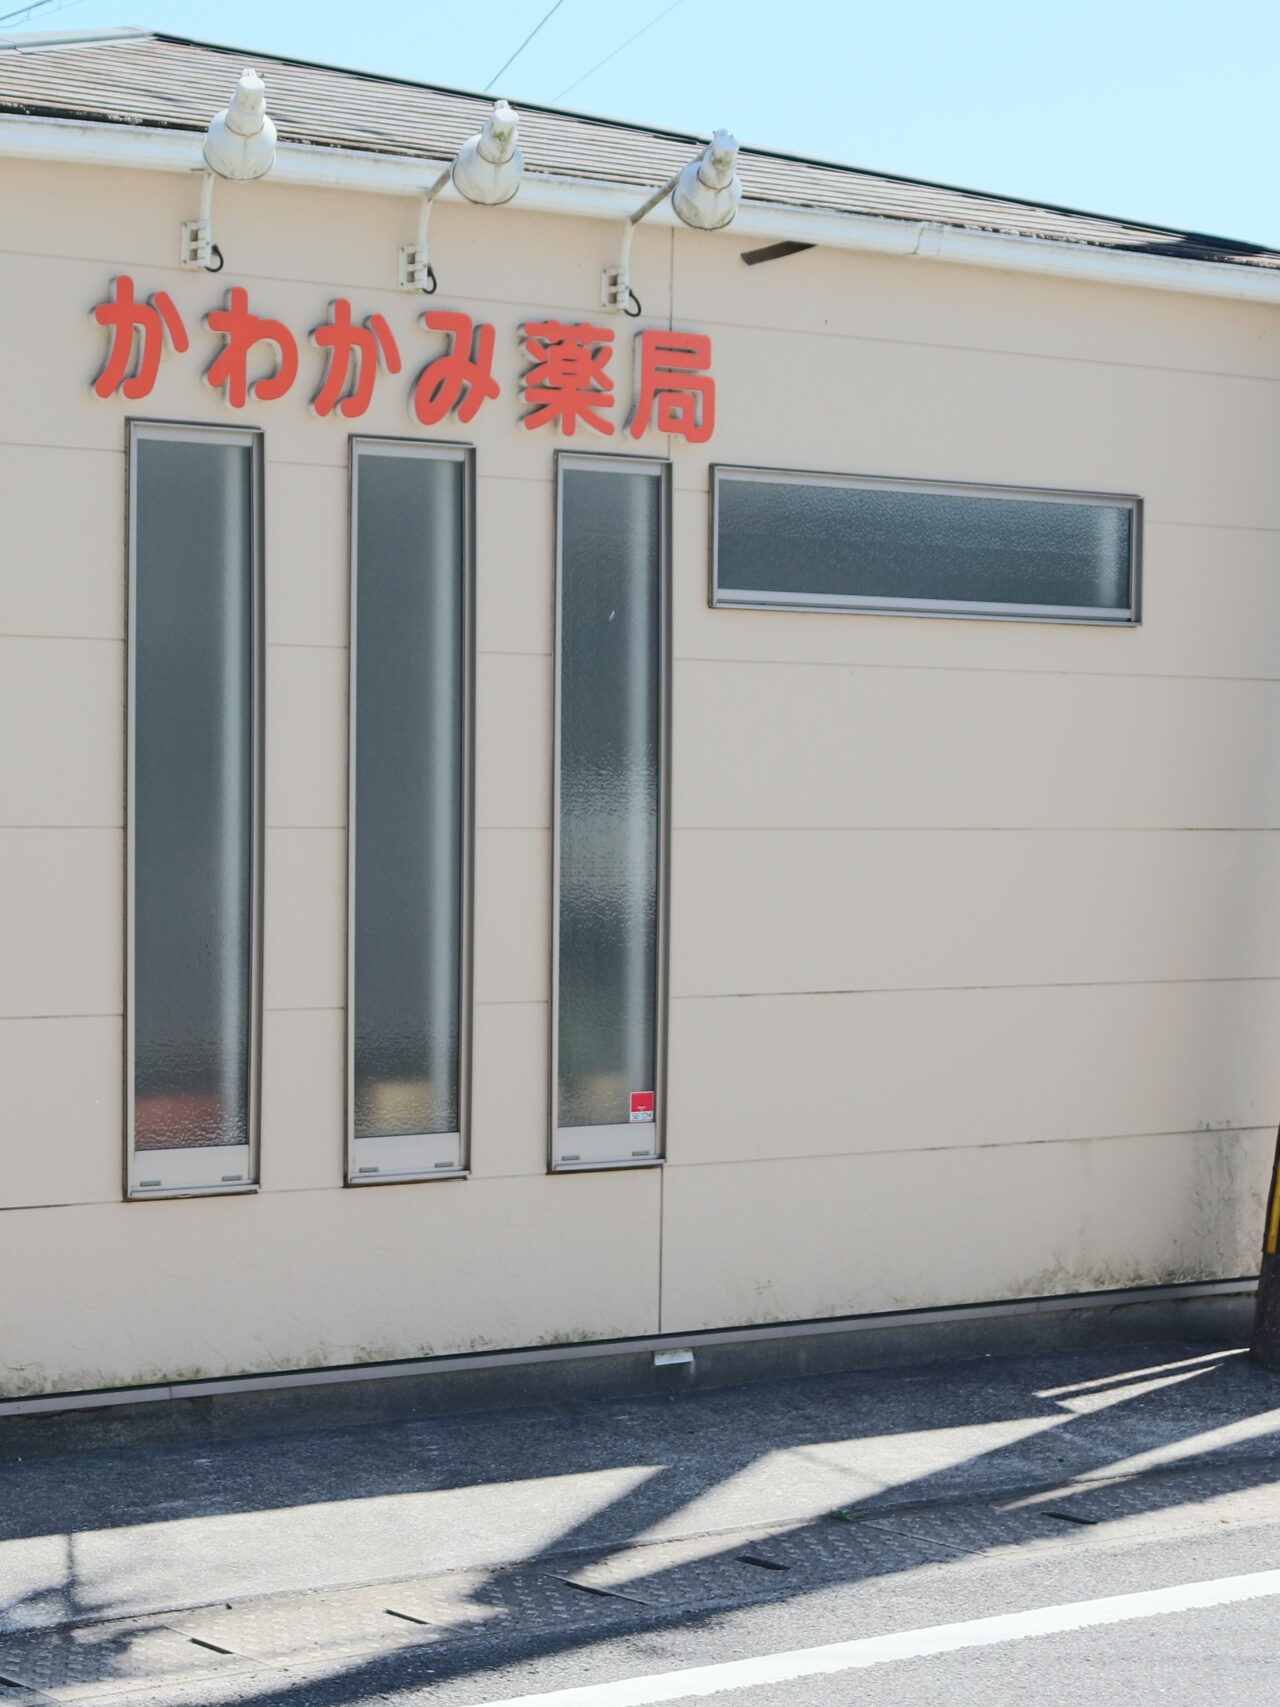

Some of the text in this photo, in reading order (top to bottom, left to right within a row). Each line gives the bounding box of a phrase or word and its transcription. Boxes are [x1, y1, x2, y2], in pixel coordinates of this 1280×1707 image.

[90, 273, 717, 443] かわかみ薬局
